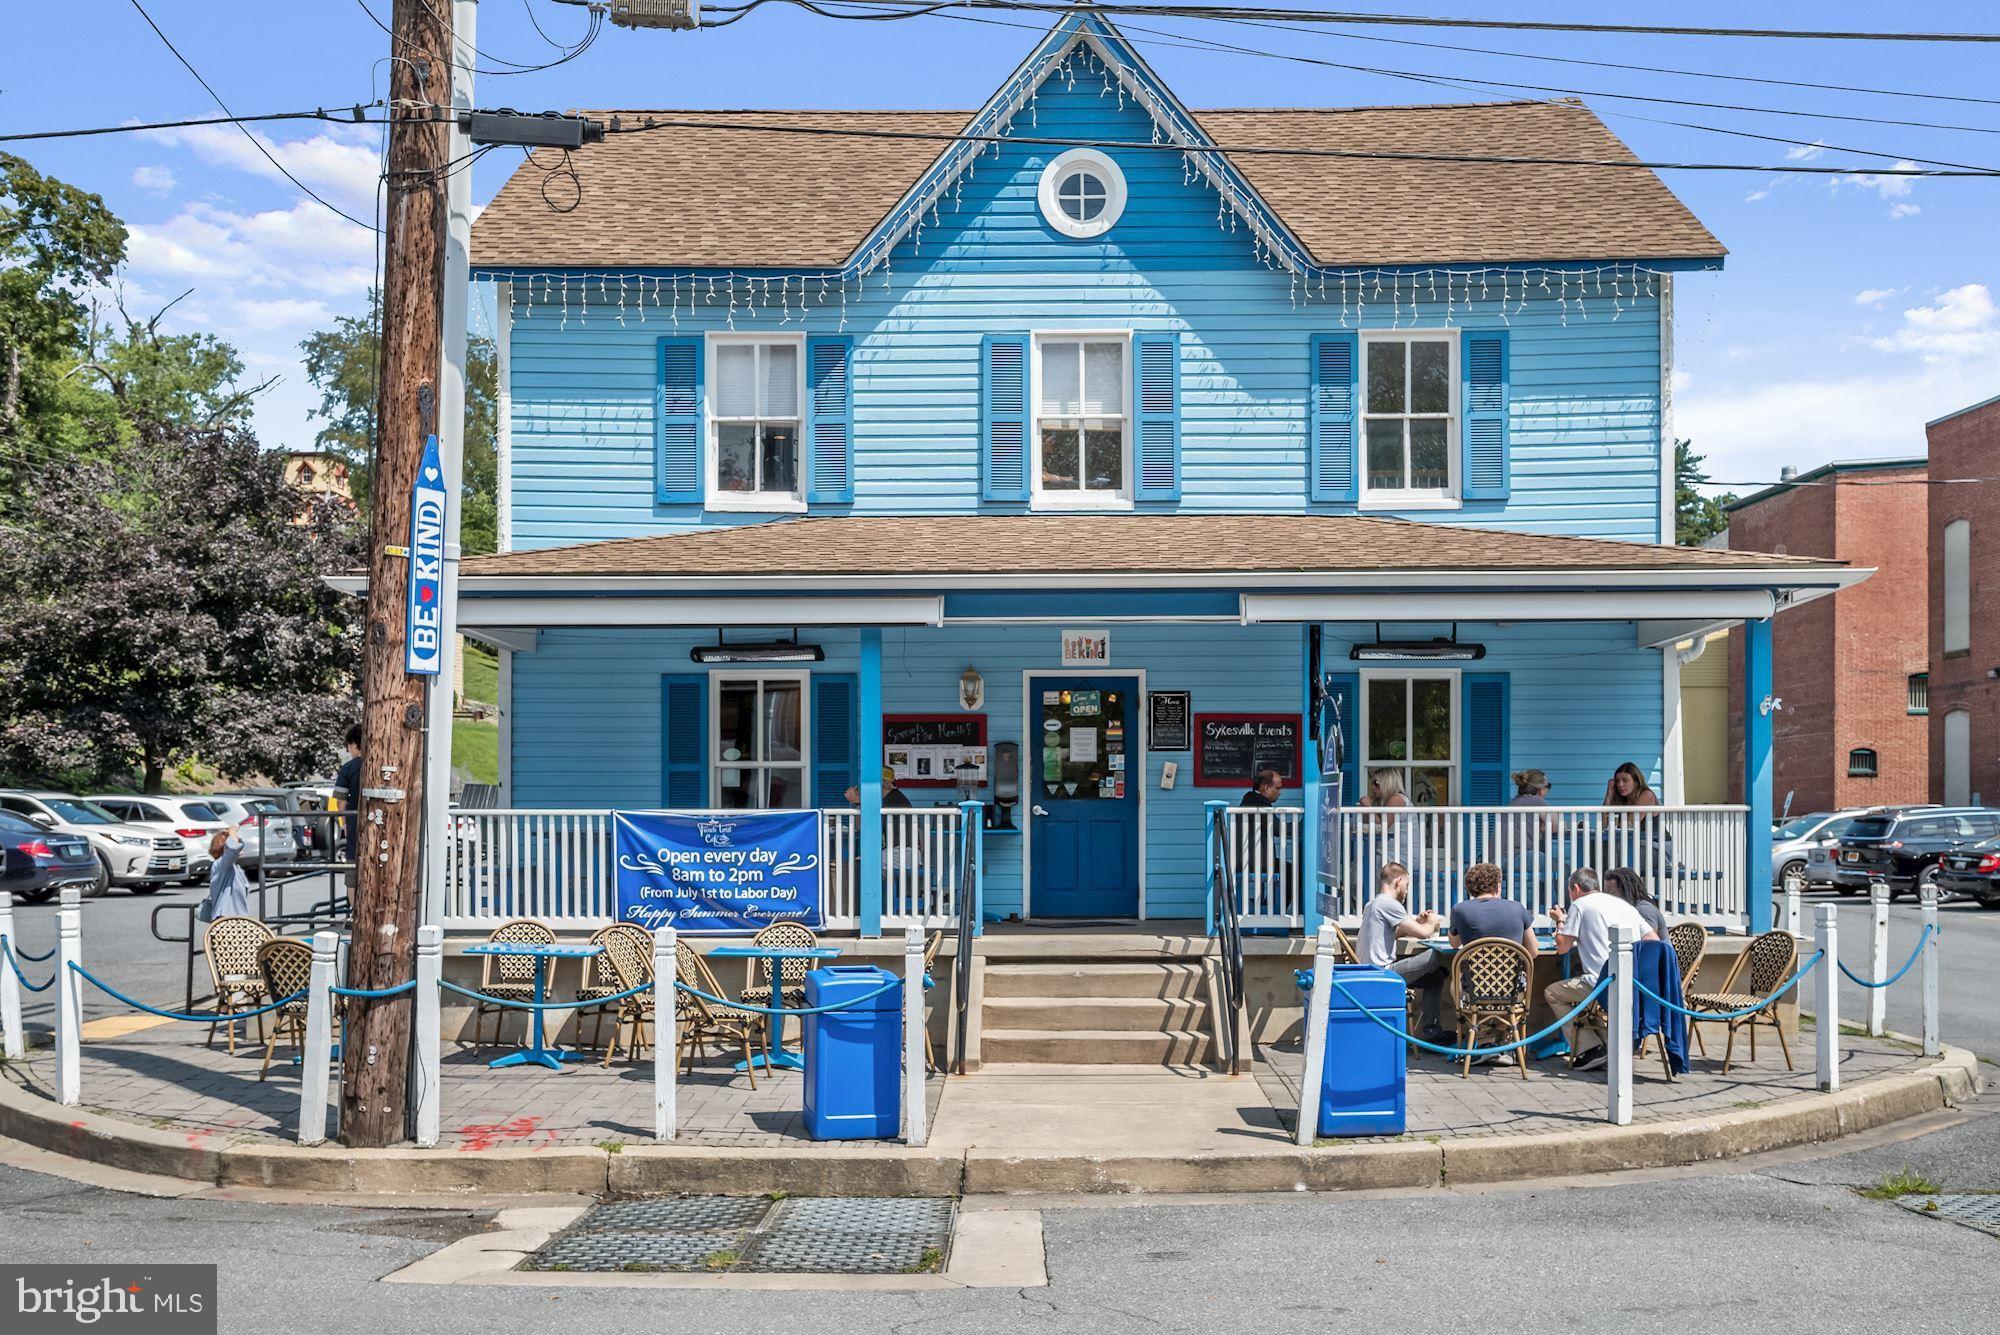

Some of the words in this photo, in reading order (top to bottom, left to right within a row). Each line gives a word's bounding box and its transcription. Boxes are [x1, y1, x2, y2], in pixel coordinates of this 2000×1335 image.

[416, 503, 442, 580] KIND
[414, 605, 438, 650] BE
[1073, 705, 1098, 713] OPEN
[1206, 722, 1256, 739] Sykesville
[1258, 723, 1293, 736] Events
[658, 848, 700, 866] Open
[704, 851, 746, 866] every
[750, 847, 777, 866] day
[672, 868, 705, 881] 8am
[708, 869, 725, 881] to
[729, 868, 763, 885] 2pm
[640, 886, 673, 899] (From
[676, 887, 698, 900] July
[701, 887, 717, 899] 1st
[720, 888, 732, 899] to
[735, 887, 768, 899] Labor
[771, 887, 797, 900] Day)
[626, 904, 676, 928] Happy
[680, 904, 739, 918] Summer
[743, 904, 811, 926] Everyone!
